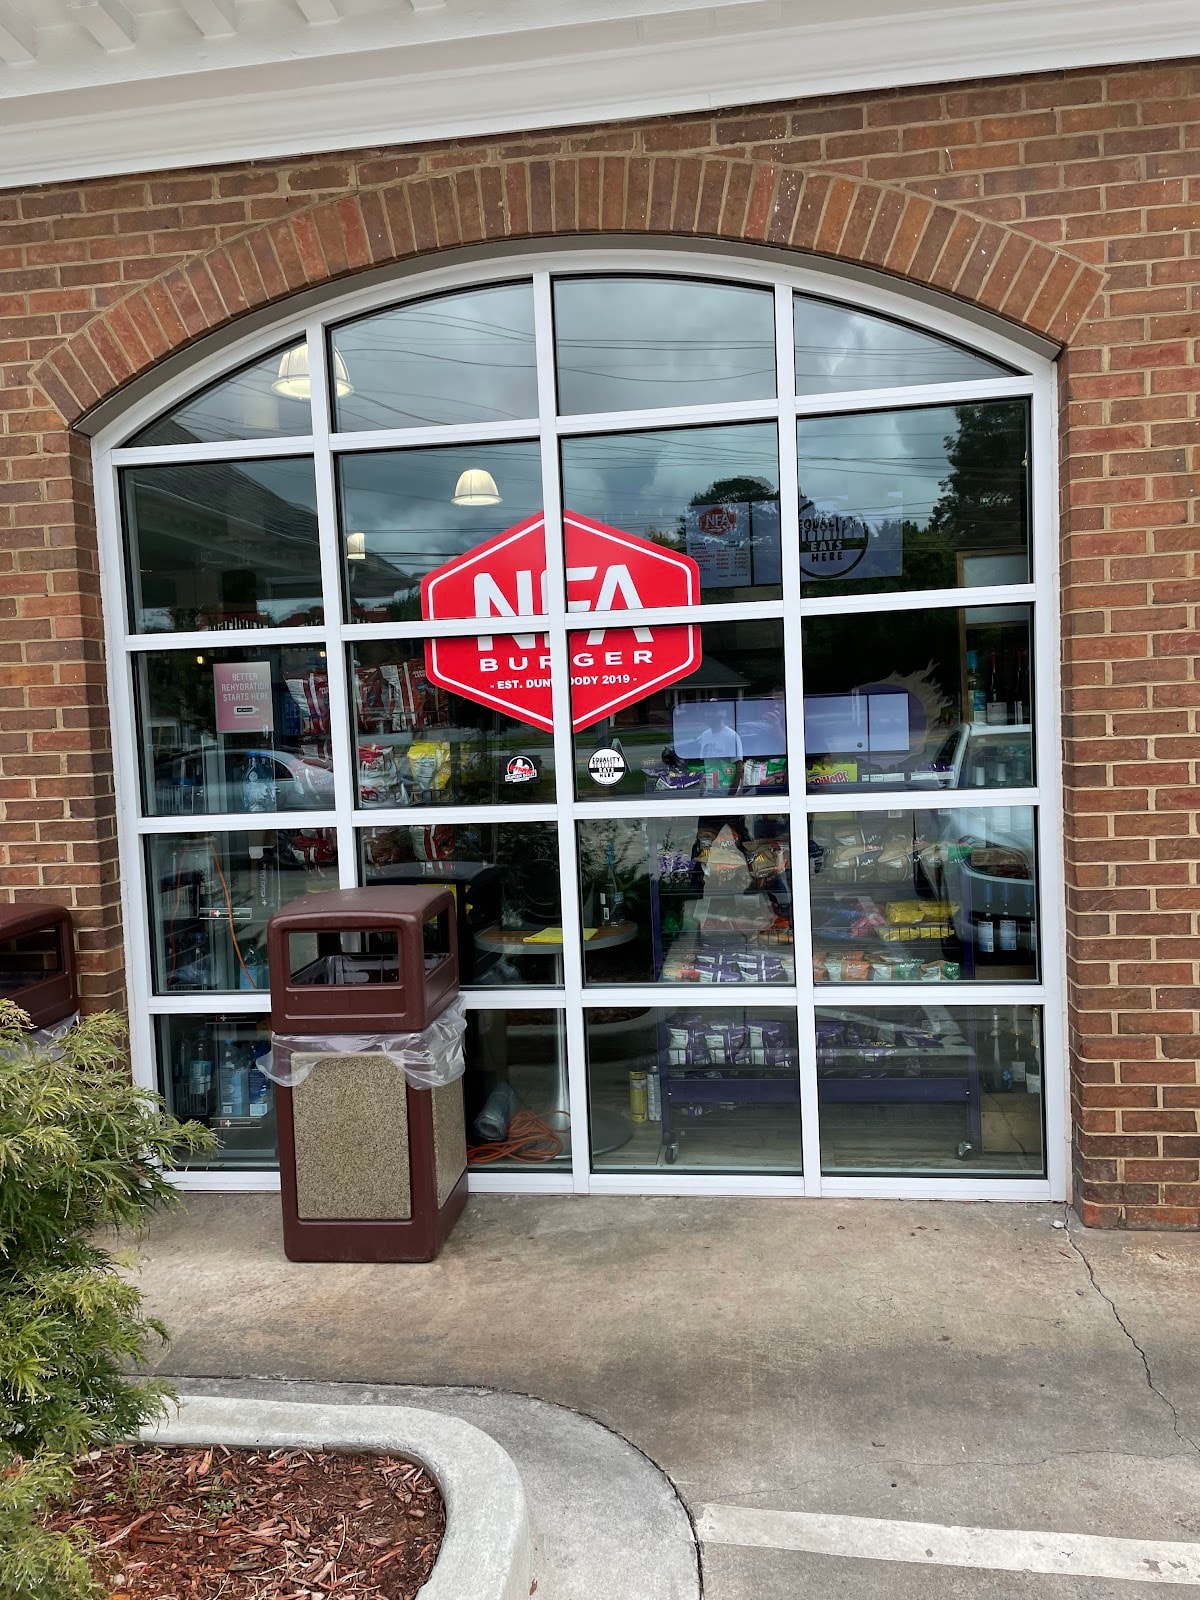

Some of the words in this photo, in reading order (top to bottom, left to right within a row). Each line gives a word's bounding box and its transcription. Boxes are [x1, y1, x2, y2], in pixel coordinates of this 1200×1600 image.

[705, 513, 731, 529] NFA
[811, 540, 842, 552] EATS
[812, 551, 843, 563] HERE
[232, 672, 258, 681] BETTER
[497, 679, 523, 690] EST.
[526, 675, 599, 688] DUNODY
[602, 674, 630, 685] 2019
[221, 682, 270, 692] REHYDRATION
[223, 692, 249, 702] STARTS
[251, 691, 269, 701] HERE
